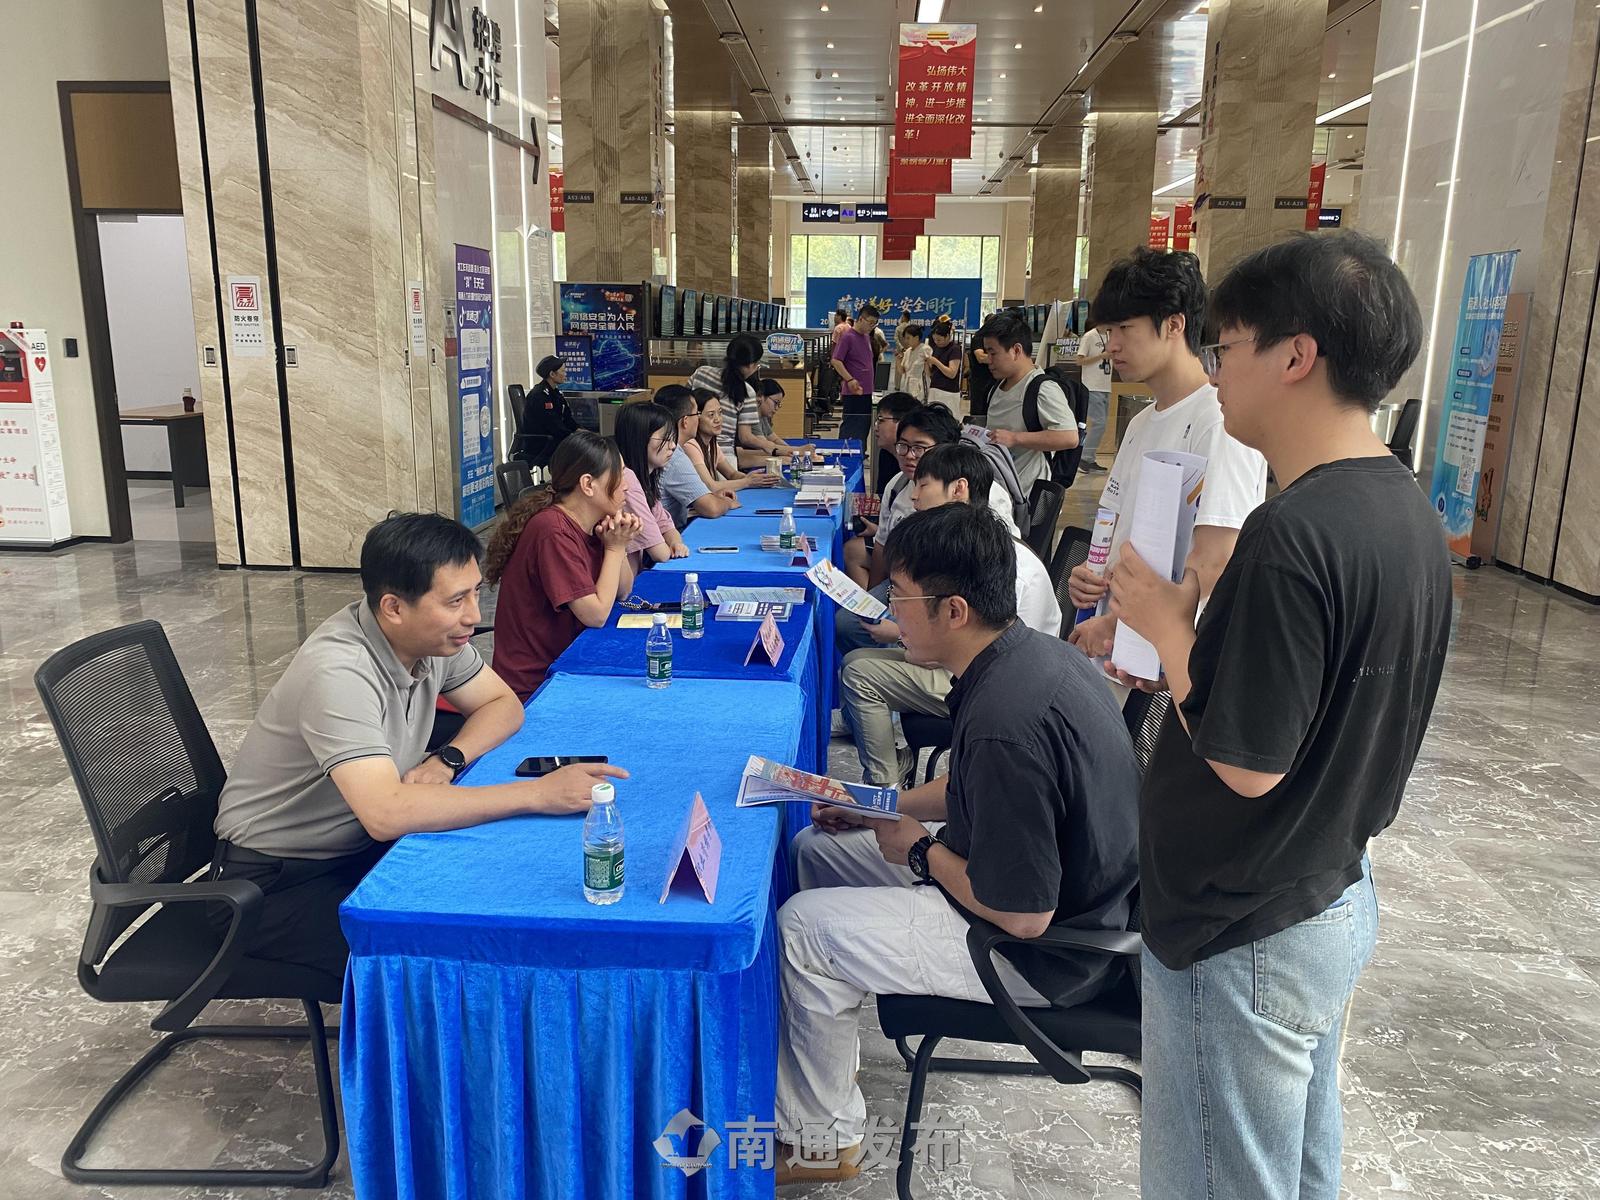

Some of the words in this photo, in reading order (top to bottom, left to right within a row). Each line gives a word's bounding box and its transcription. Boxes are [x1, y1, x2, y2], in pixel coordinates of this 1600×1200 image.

[926, 65, 968, 76] 弘扬伟大
[904, 81, 967, 92] 改革开放精
[903, 113, 966, 124] 进全面深化改
[569, 312, 635, 322] 网络安全为人民
[570, 321, 635, 331] 网络安全靠人民
[32, 342, 46, 350] AED
